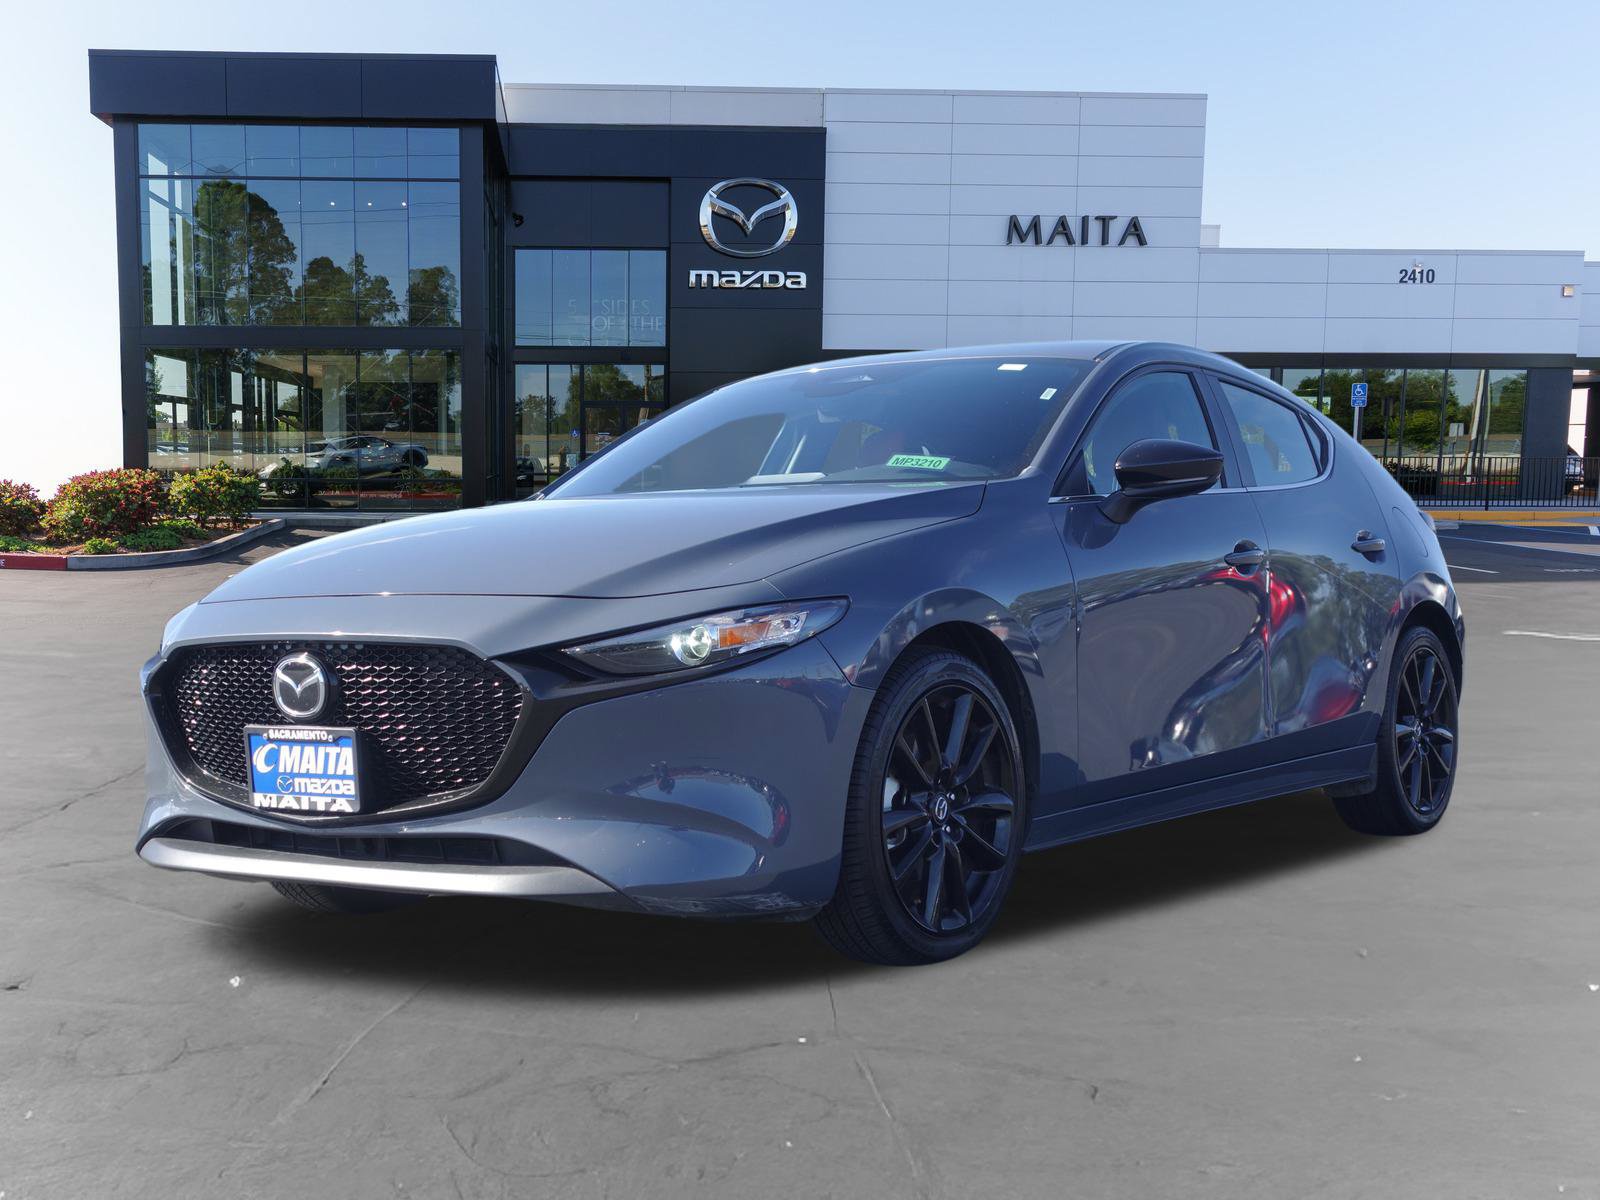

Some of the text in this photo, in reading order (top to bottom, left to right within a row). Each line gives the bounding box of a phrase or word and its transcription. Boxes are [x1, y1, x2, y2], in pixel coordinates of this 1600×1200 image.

[1006, 215, 1148, 246] MAITA
[1398, 268, 1436, 284] 2410
[891, 457, 943, 468] MP3210
[268, 729, 328, 741] SACRAMENTO
[278, 745, 354, 775] MAITA
[253, 793, 354, 812] MAITA
